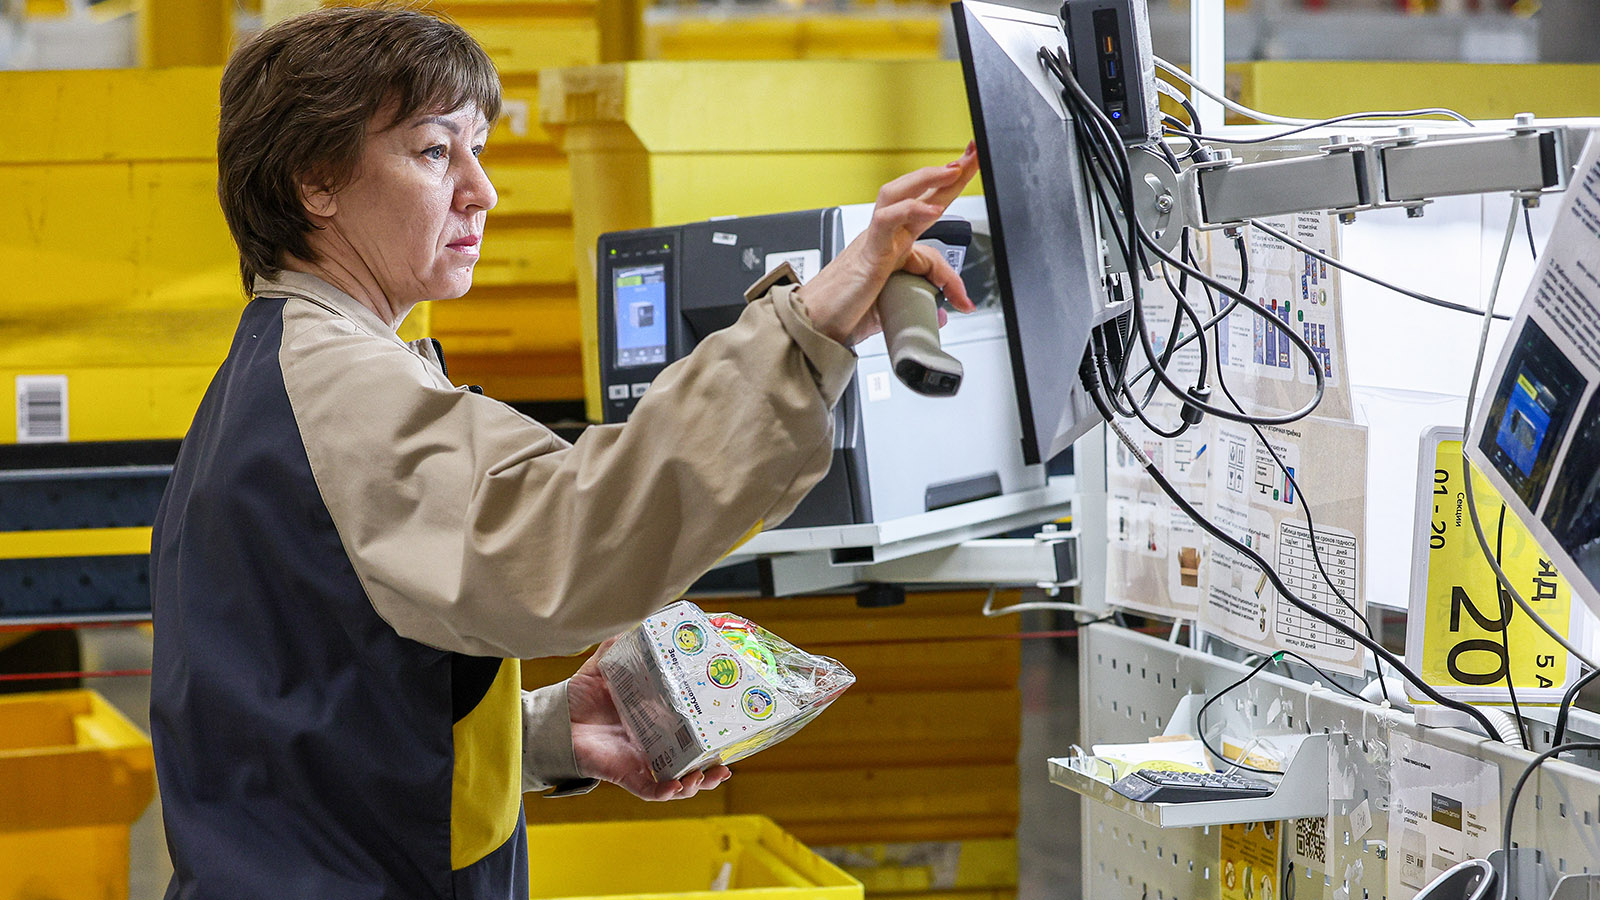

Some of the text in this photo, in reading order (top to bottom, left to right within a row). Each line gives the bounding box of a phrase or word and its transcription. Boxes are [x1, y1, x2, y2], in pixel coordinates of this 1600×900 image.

[1433, 469, 1449, 495] 01
[1455, 492, 1465, 527] Секции
[1430, 521, 1446, 549] 20
[1447, 585, 1513, 685] 20
[1536, 654, 1555, 668] 5
